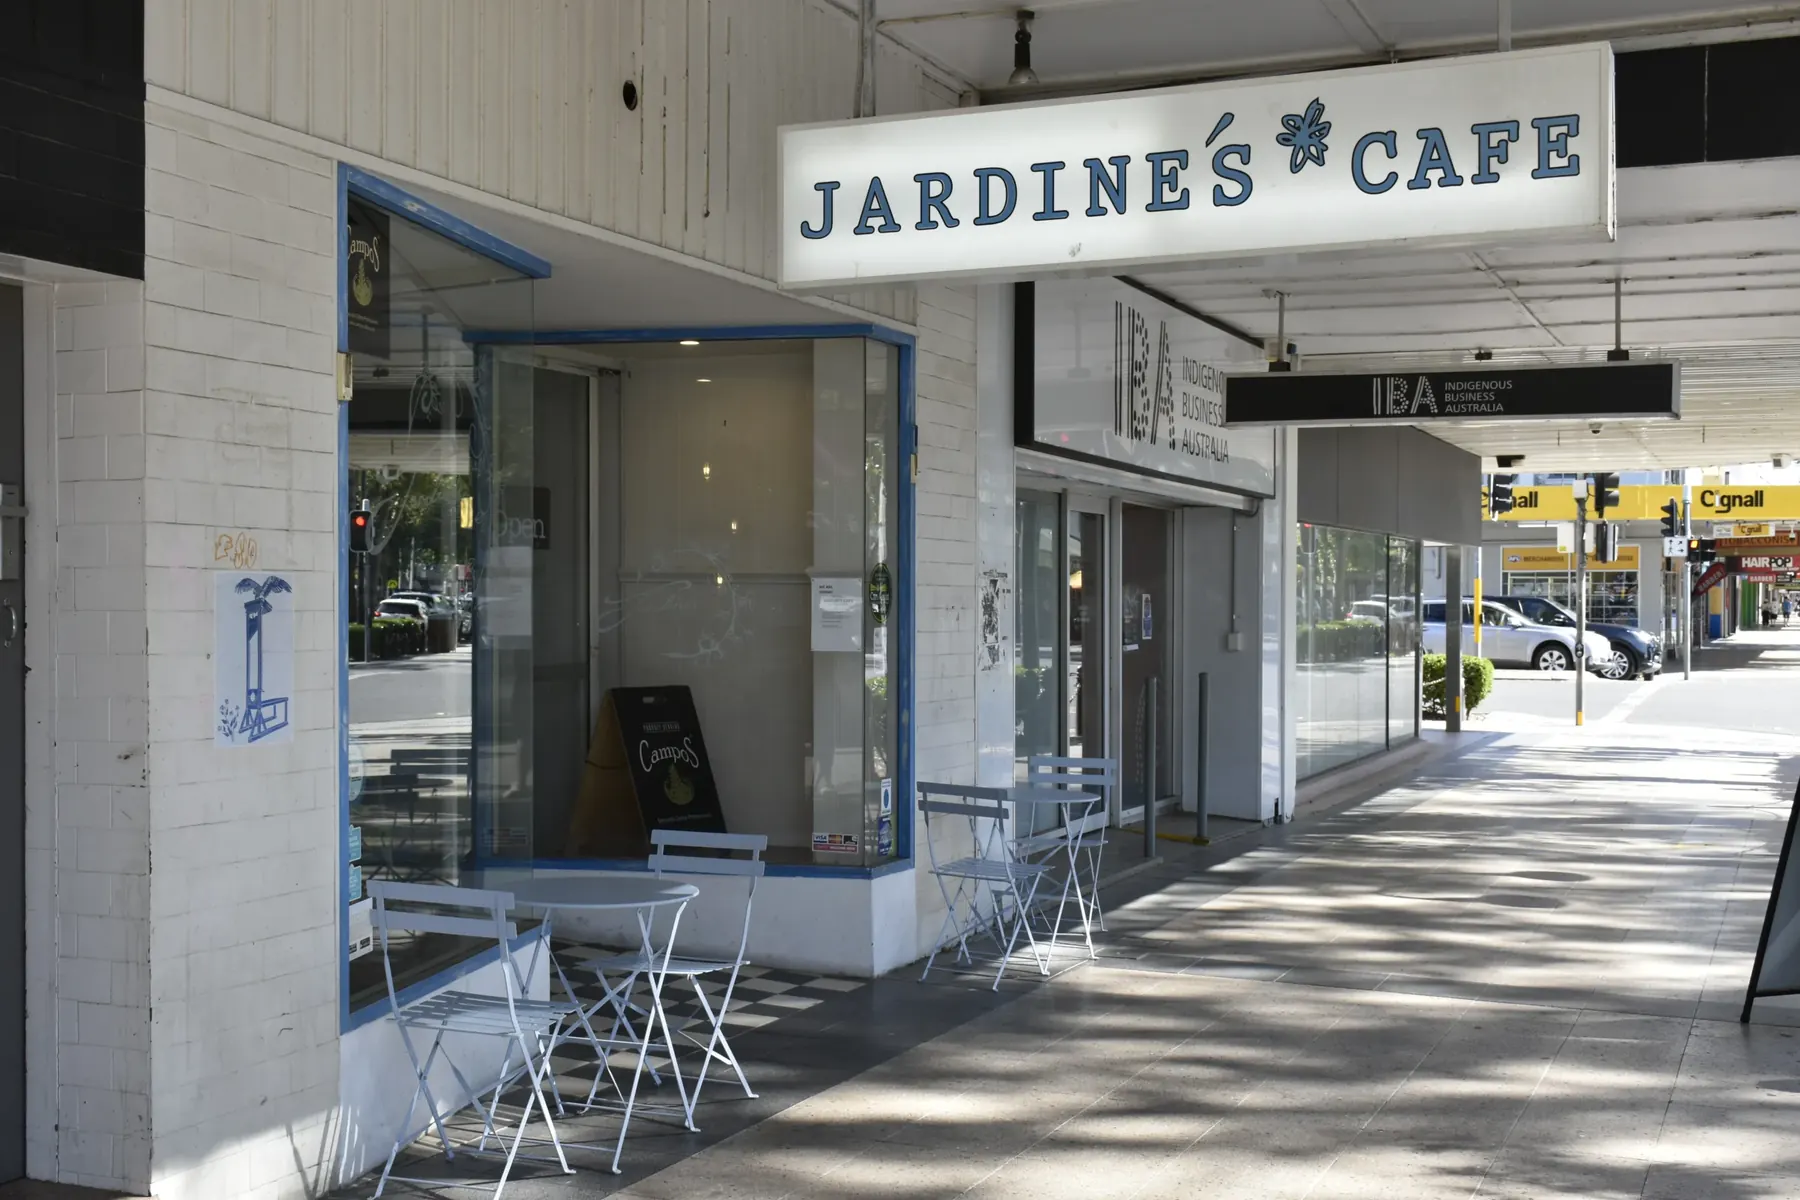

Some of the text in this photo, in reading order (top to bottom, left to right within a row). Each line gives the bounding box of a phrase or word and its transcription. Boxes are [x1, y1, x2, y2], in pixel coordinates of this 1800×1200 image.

[799, 111, 1582, 241] JARDINE'S CAFE
[1373, 375, 1439, 415] IBA
[1444, 380, 1513, 391] INDIGENOUS
[1444, 392, 1495, 402] BUSINESS
[1182, 391, 1224, 428] BUSINESS
[1444, 403, 1504, 413] AUSTRALIA
[1181, 428, 1229, 463] AUSTRALIA
[1700, 489, 1764, 513] Cignall
